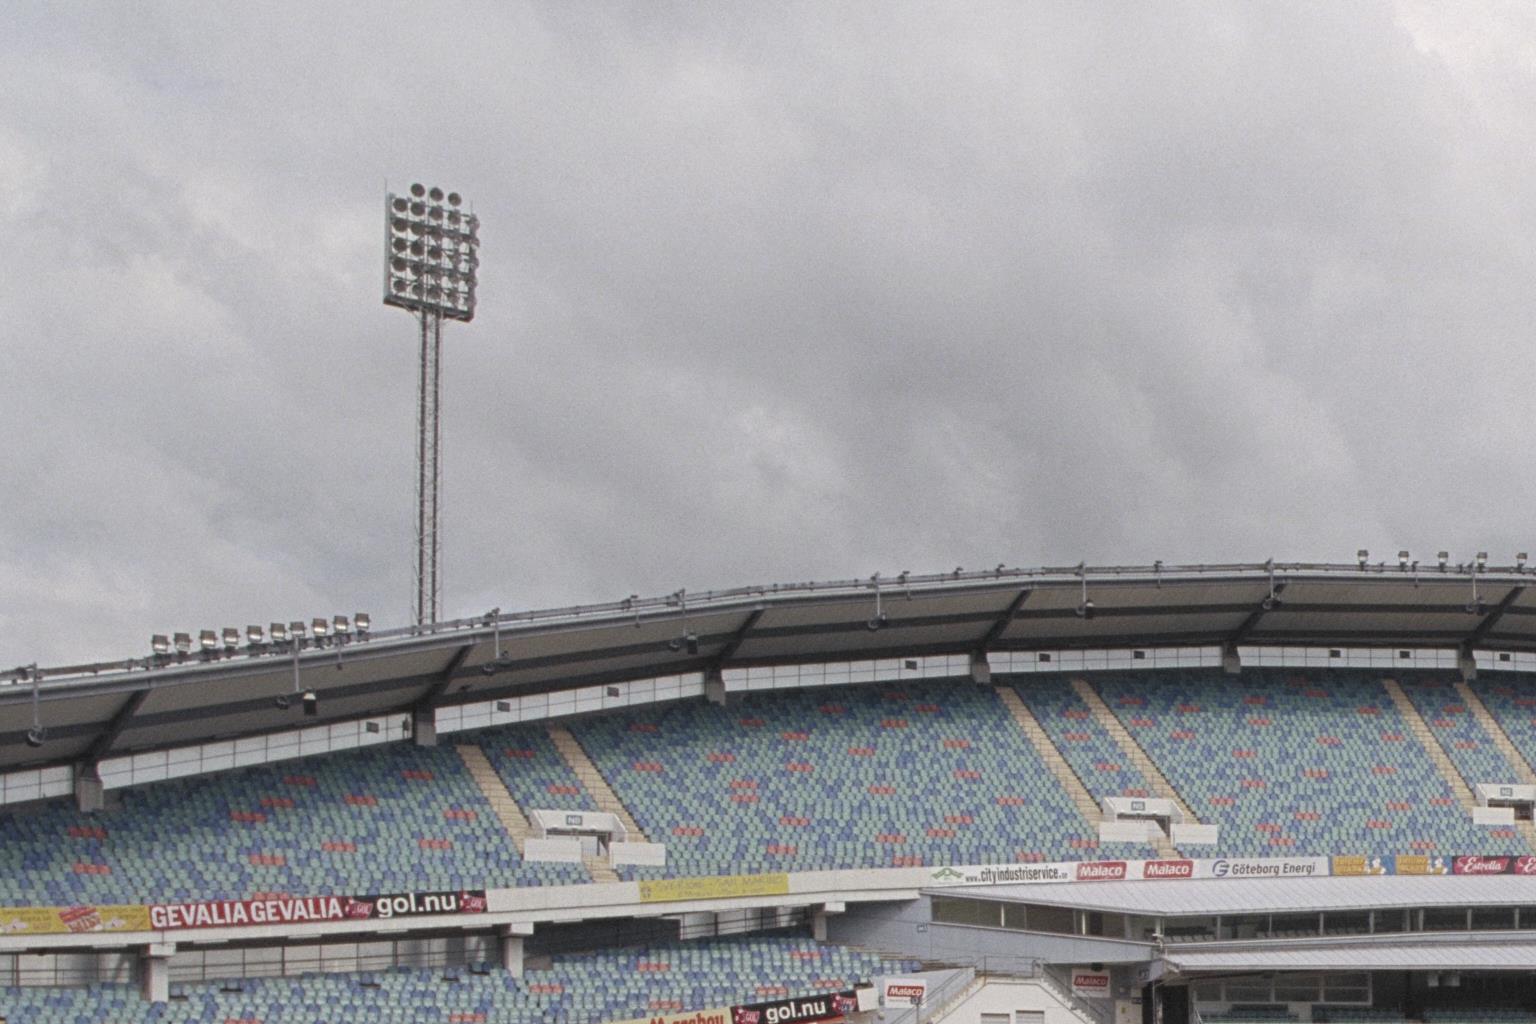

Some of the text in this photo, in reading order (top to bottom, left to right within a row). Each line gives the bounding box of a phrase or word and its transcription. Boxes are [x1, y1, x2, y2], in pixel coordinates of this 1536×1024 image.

[1080, 864, 1123, 878] Malaco
[1147, 863, 1190, 877] Malaco
[1232, 862, 1316, 875] Göteborg Energi
[1464, 857, 1501, 873] Estrella
[151, 902, 248, 928] GEVALIA
[251, 896, 343, 922] GEVALIA
[376, 892, 456, 918] gol.nu
[889, 986, 922, 997] Malaco
[766, 1001, 827, 1024] gol.nu
